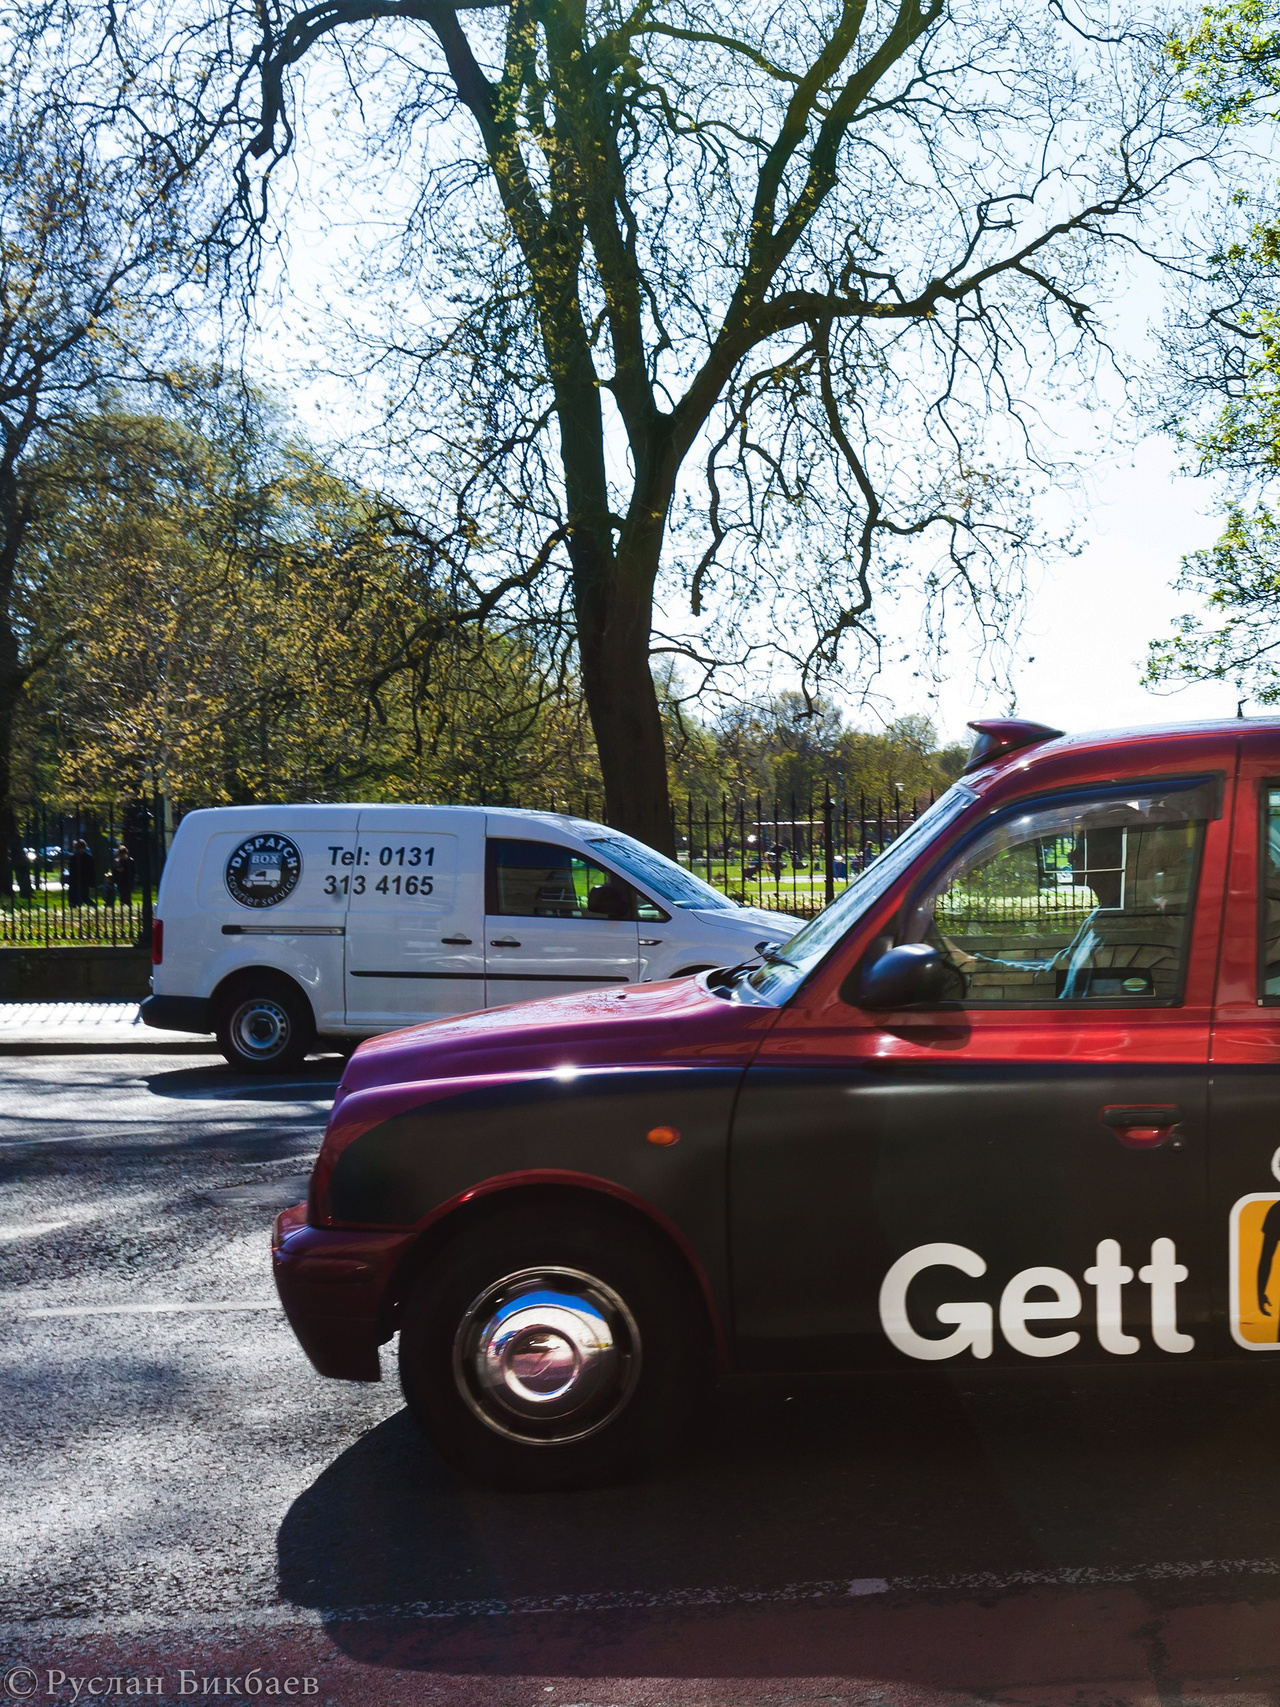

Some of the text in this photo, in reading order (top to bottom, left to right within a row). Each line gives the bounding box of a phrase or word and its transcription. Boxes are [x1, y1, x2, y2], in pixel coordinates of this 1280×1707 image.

[231, 837, 298, 868] DISPATCH
[251, 855, 279, 864] BOX
[327, 846, 435, 867] Tel: 0131
[228, 875, 298, 907] courier service
[323, 875, 434, 896] 313 4165
[878, 1237, 1196, 1361] Gett
